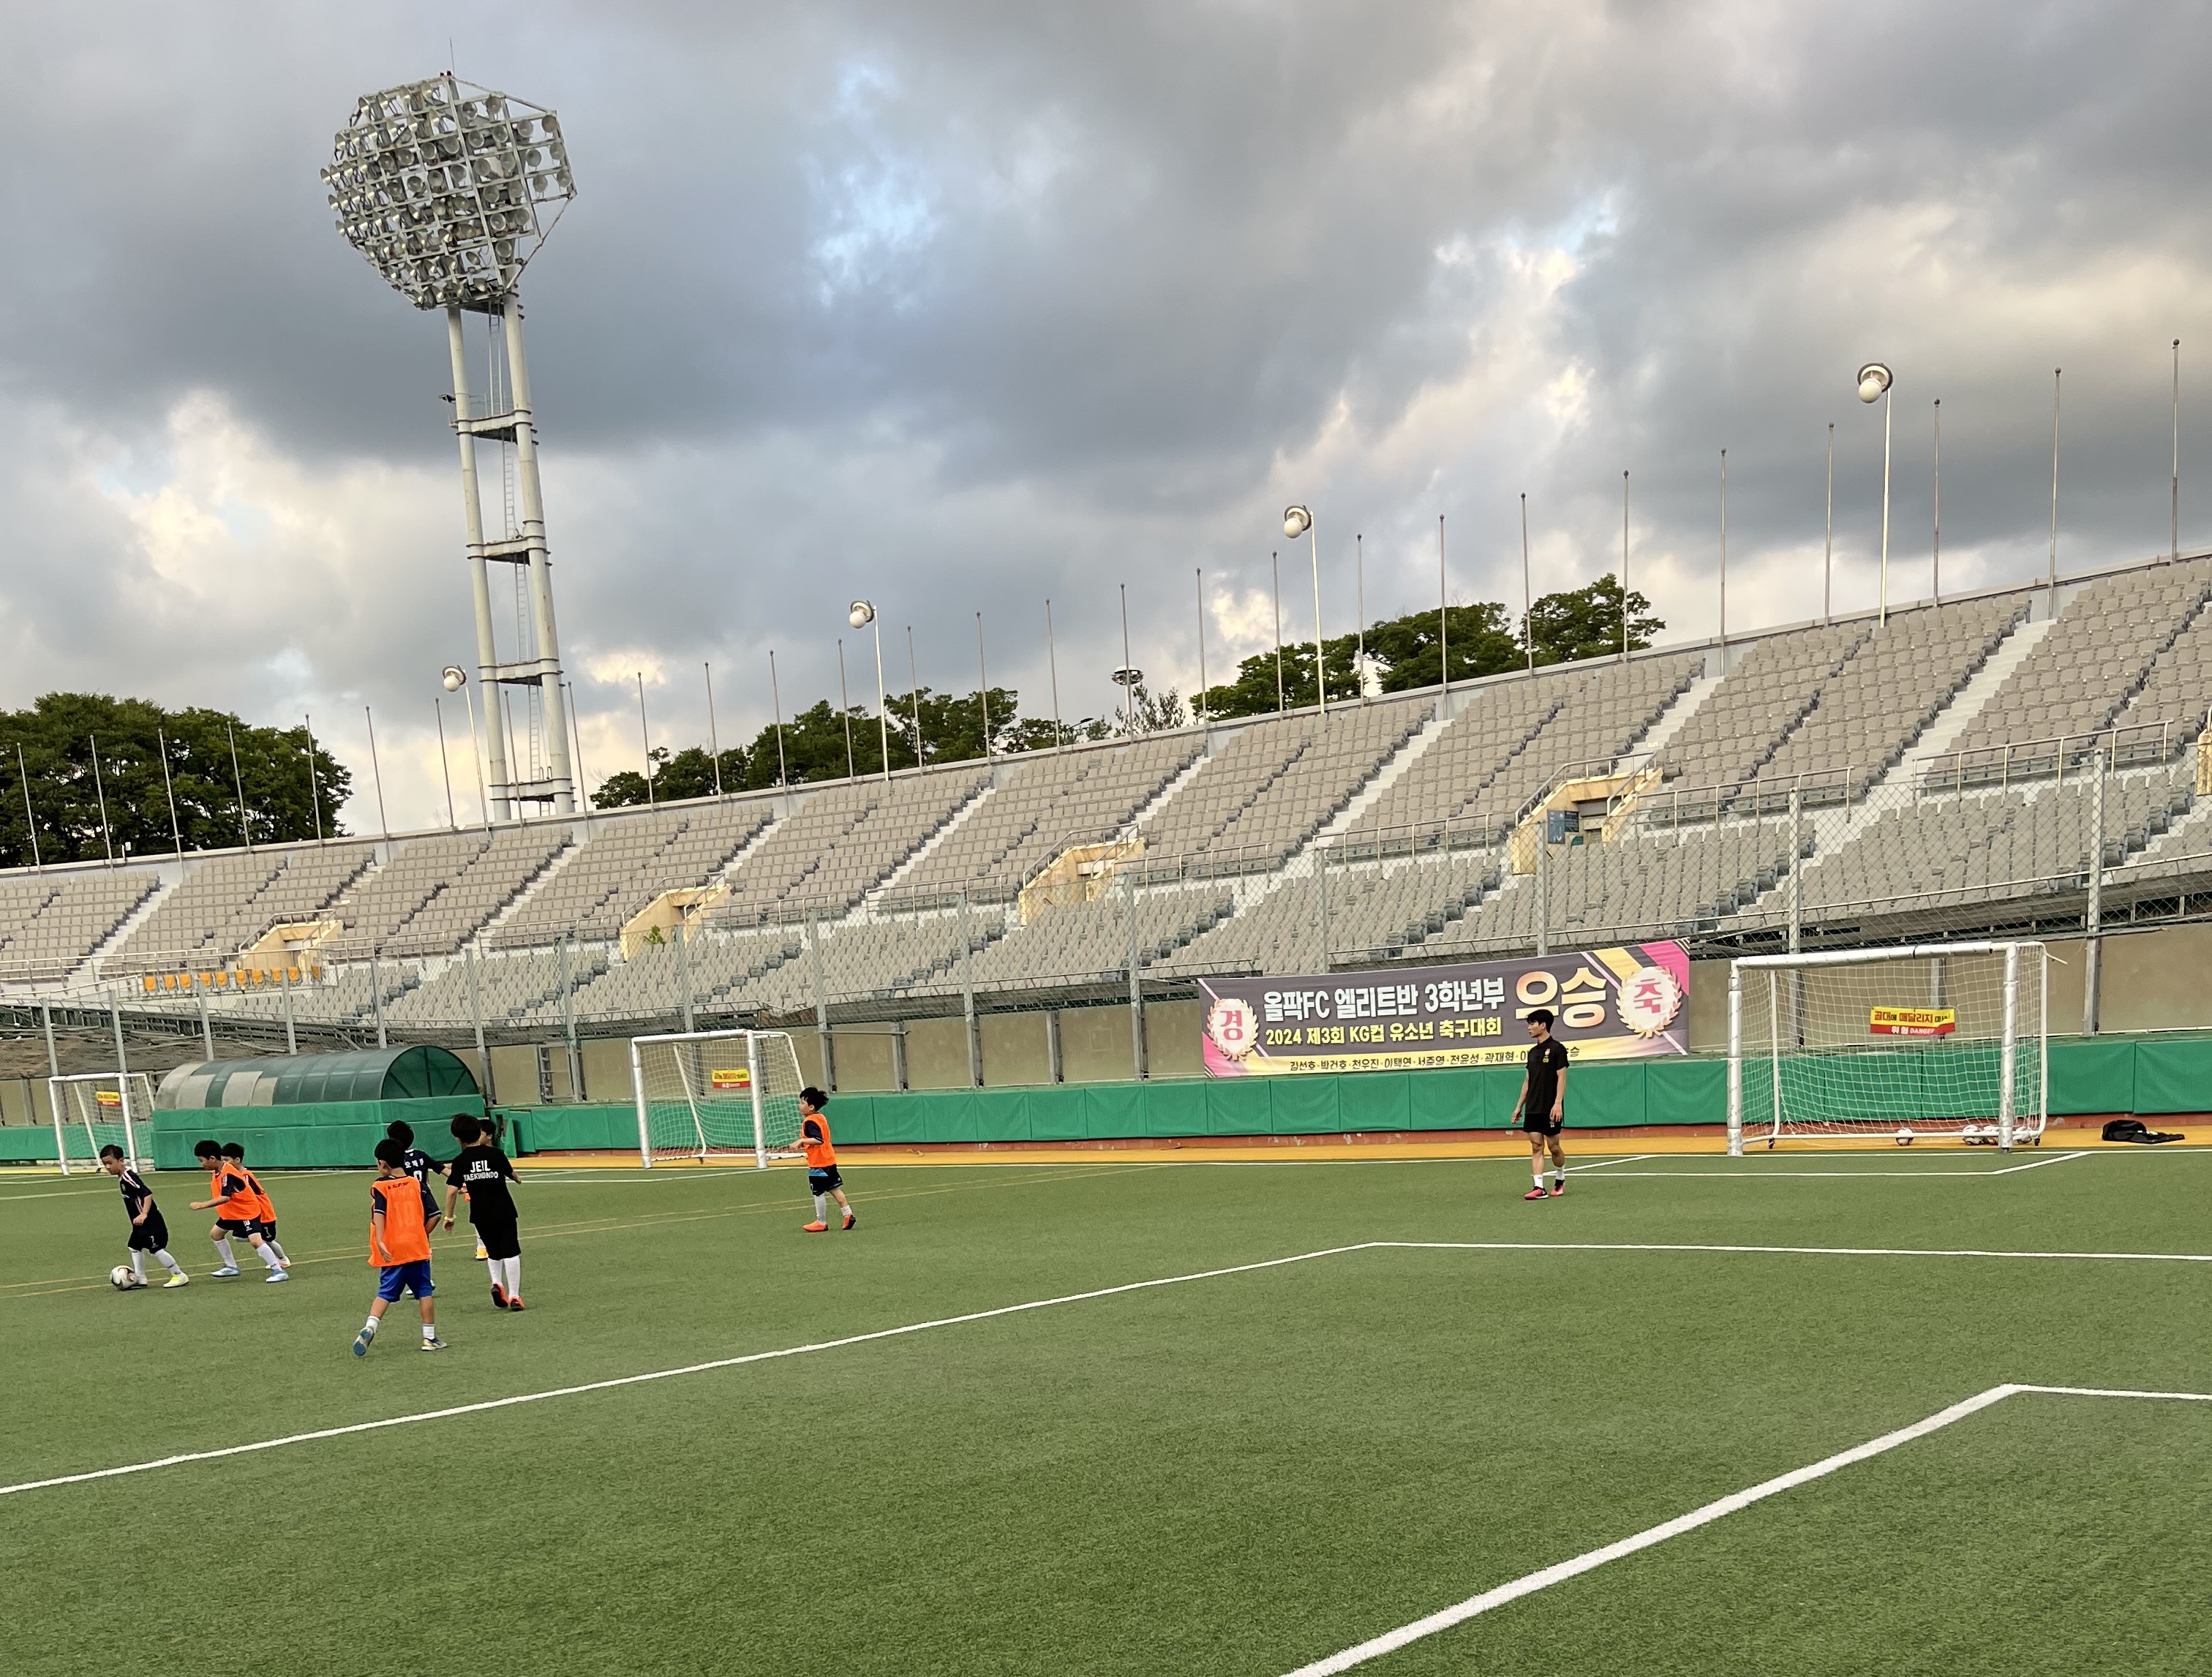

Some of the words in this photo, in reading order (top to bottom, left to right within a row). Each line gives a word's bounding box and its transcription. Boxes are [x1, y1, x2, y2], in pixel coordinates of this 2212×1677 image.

[1264, 990, 1331, 1022] 올팍FC
[1334, 984, 1419, 1020] 엘리트반
[1425, 977, 1505, 1013] 3학년부
[1515, 967, 1607, 1028] 우승
[1633, 979, 1663, 1013] 축
[1220, 1009, 1244, 1041] 경
[1265, 1028, 1302, 1045] 2024
[1306, 1026, 1345, 1045] 제3회
[1350, 1024, 1385, 1043] KG컵
[1390, 1021, 1434, 1041] 유소년
[1439, 1017, 1502, 1039] 축구대회
[1900, 1013, 1933, 1022] 매달리지
[470, 1159, 491, 1173] JEIL
